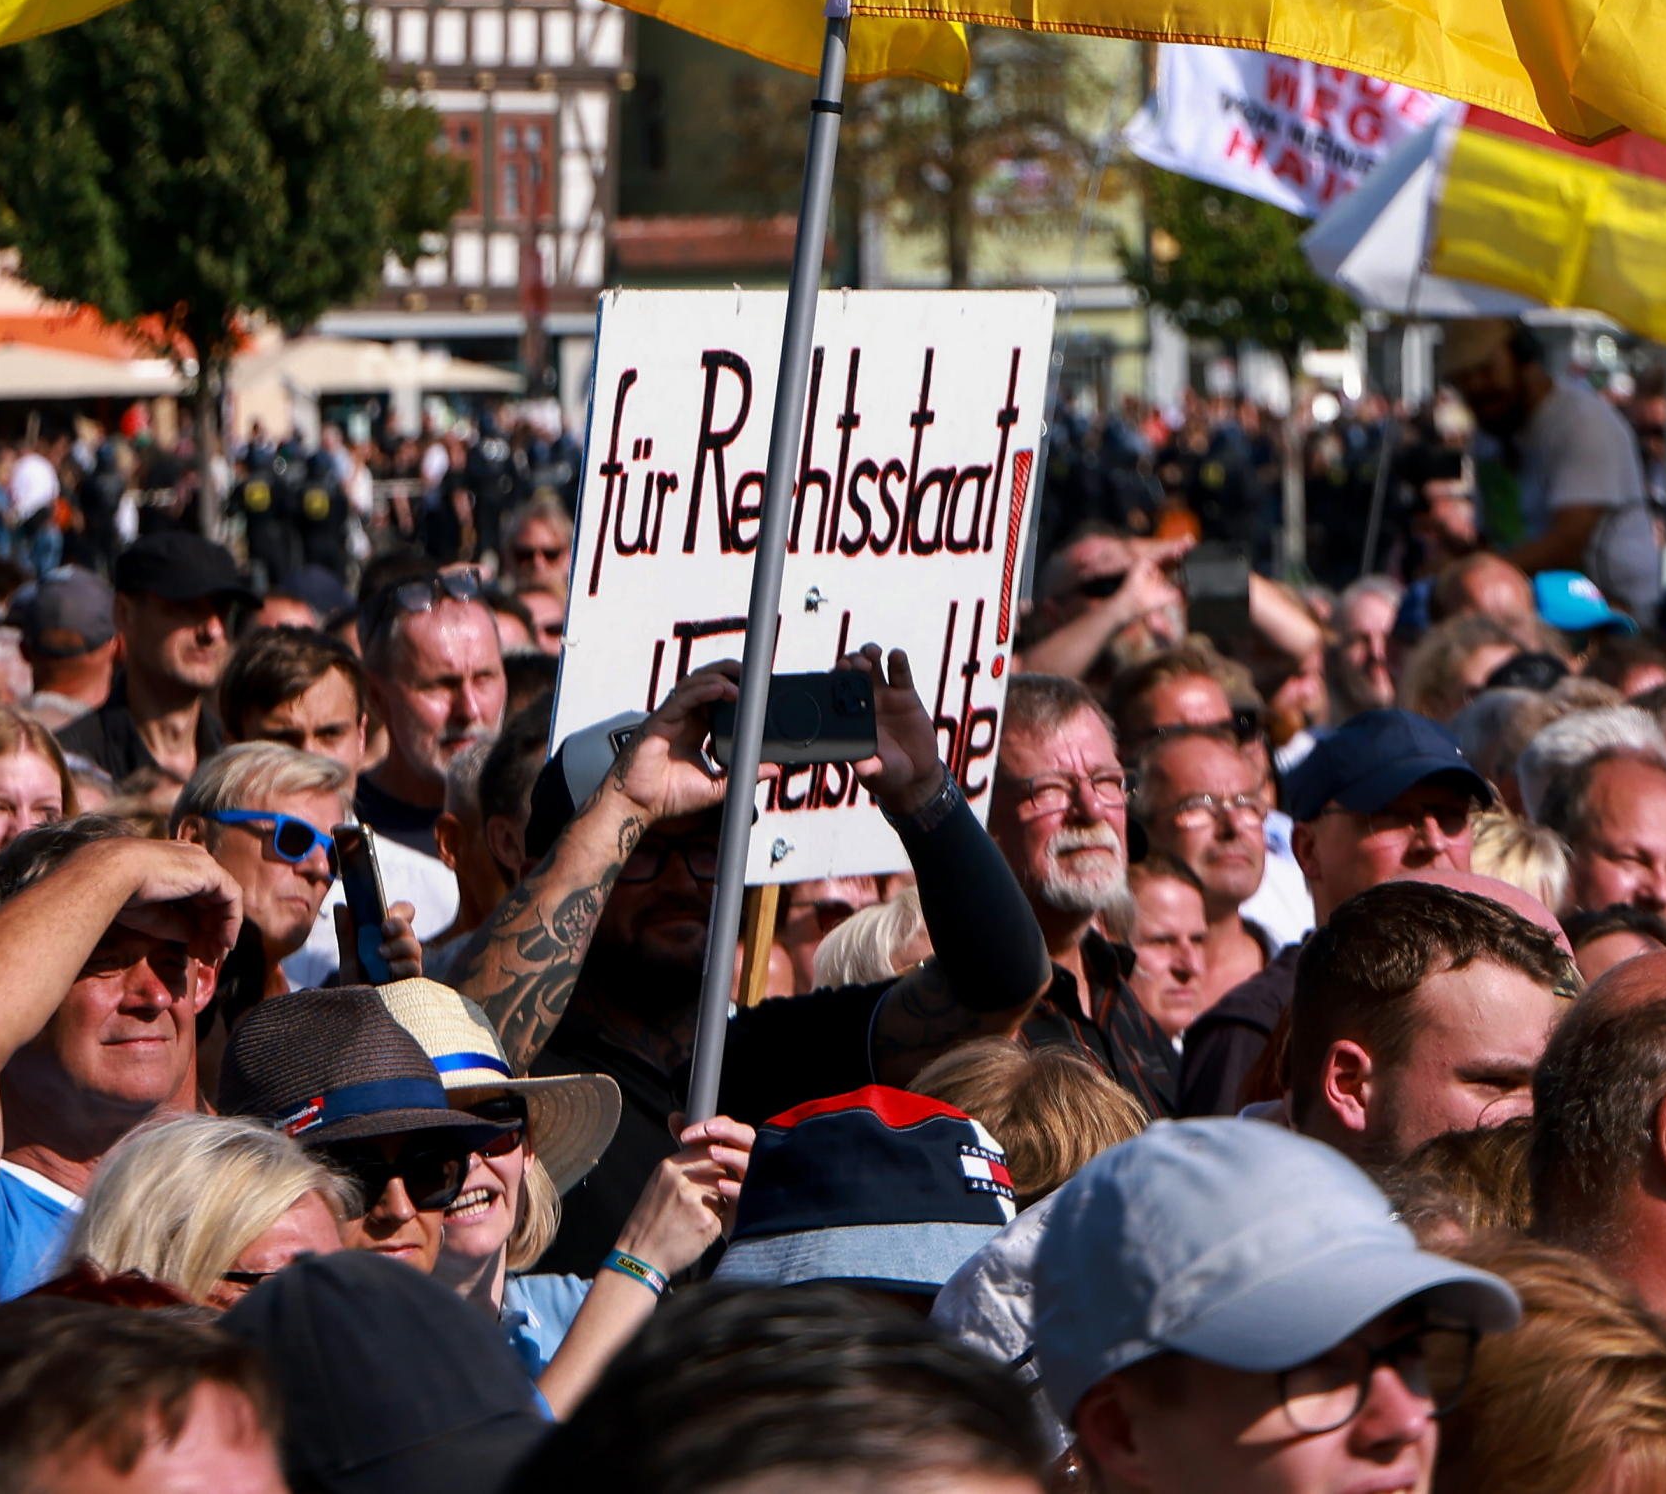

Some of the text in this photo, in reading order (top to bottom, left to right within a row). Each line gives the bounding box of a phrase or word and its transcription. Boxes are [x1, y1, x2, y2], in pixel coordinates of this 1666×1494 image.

[589, 367, 679, 597] für
[682, 346, 1021, 557] Rehtsstaat
[972, 1179, 1013, 1199] JEANS
